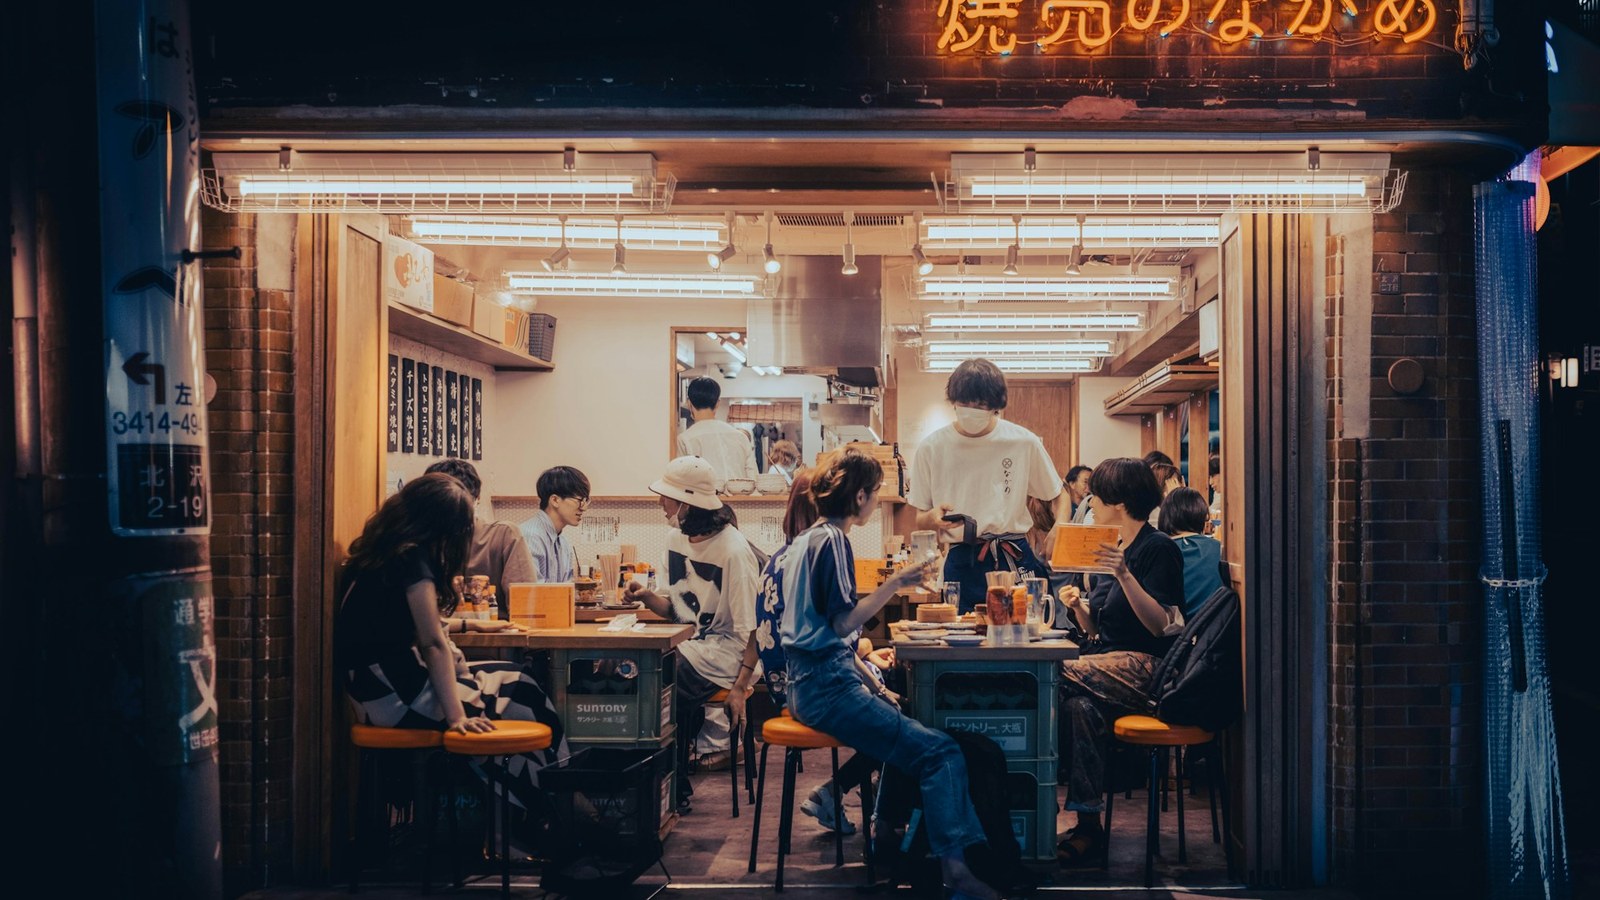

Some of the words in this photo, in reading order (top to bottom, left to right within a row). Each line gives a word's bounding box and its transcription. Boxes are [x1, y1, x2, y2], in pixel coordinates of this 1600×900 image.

[406, 370, 414, 447] チーズ焼売
[576, 704, 628, 713] SUNTORY
